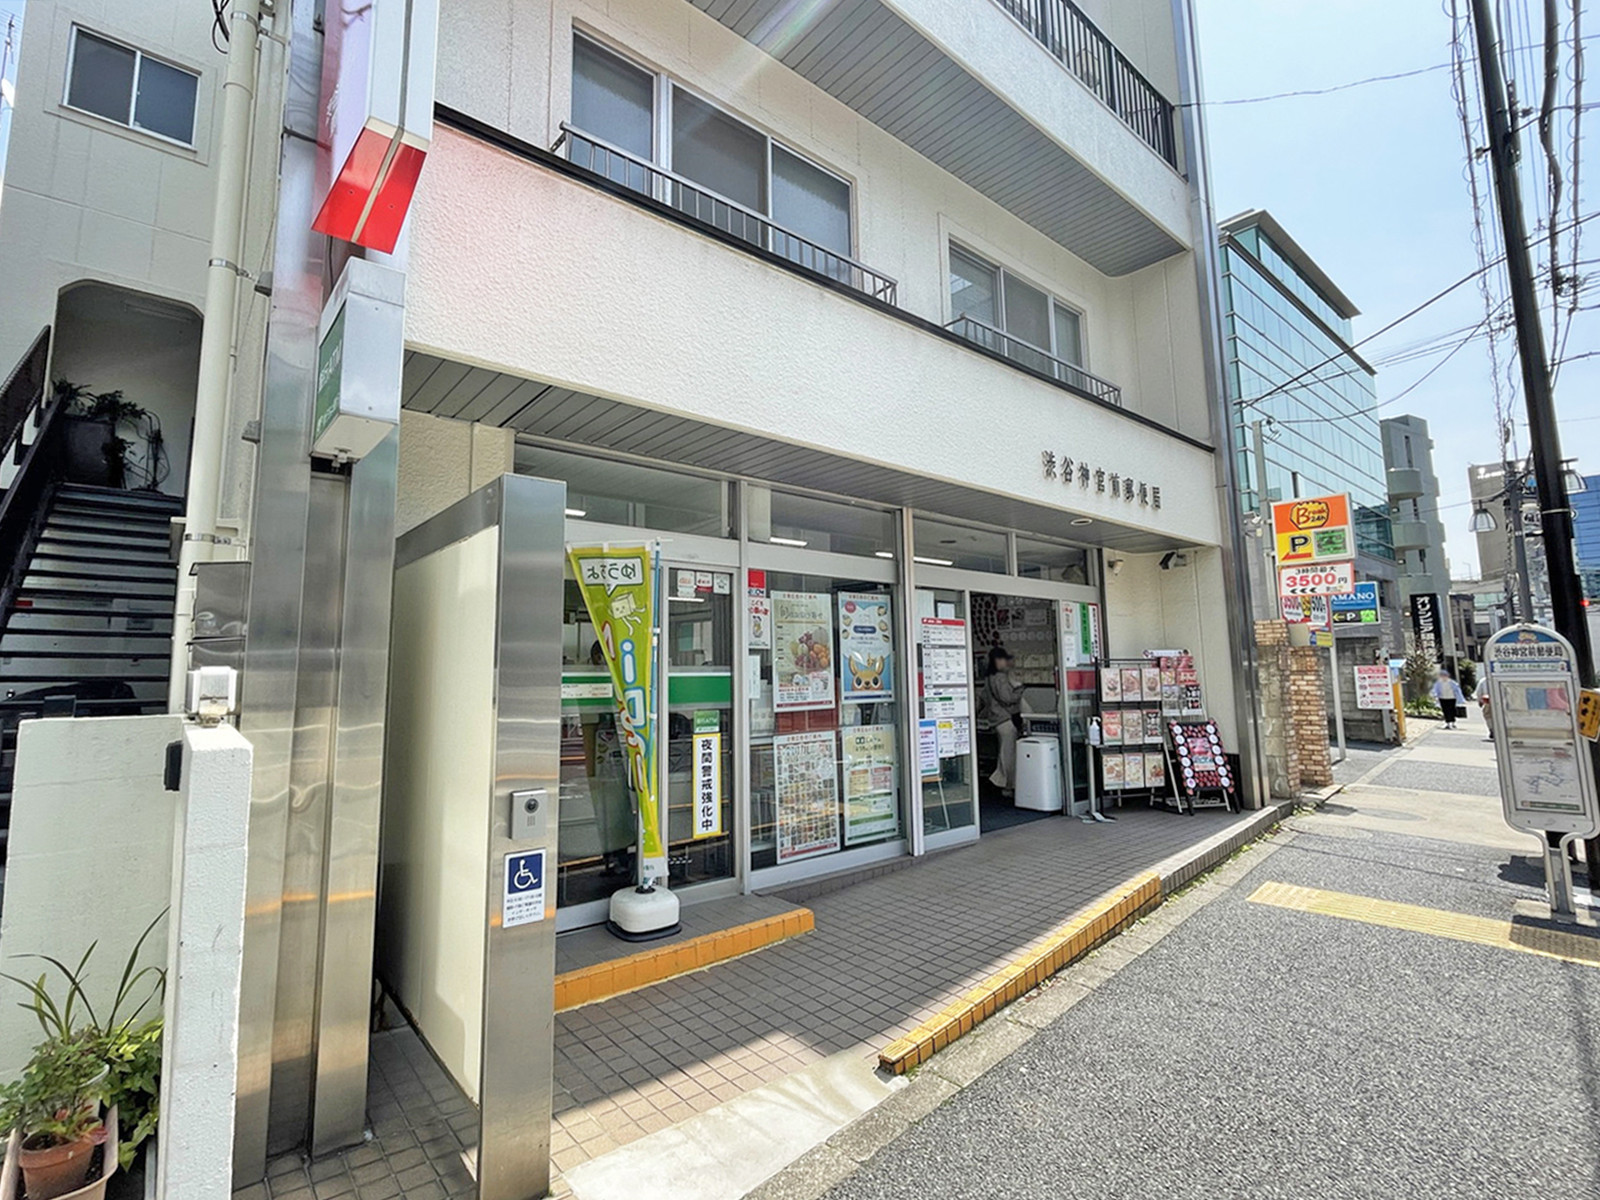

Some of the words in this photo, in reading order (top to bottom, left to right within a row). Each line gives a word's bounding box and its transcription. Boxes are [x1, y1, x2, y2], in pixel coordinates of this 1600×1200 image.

[1042, 449, 1161, 510] 渋谷神宮前郵便局
[1291, 536, 1309, 552] P
[1330, 592, 1374, 601] AMANO
[1346, 612, 1356, 621] P
[701, 739, 713, 831] 夜間警戒強化中
